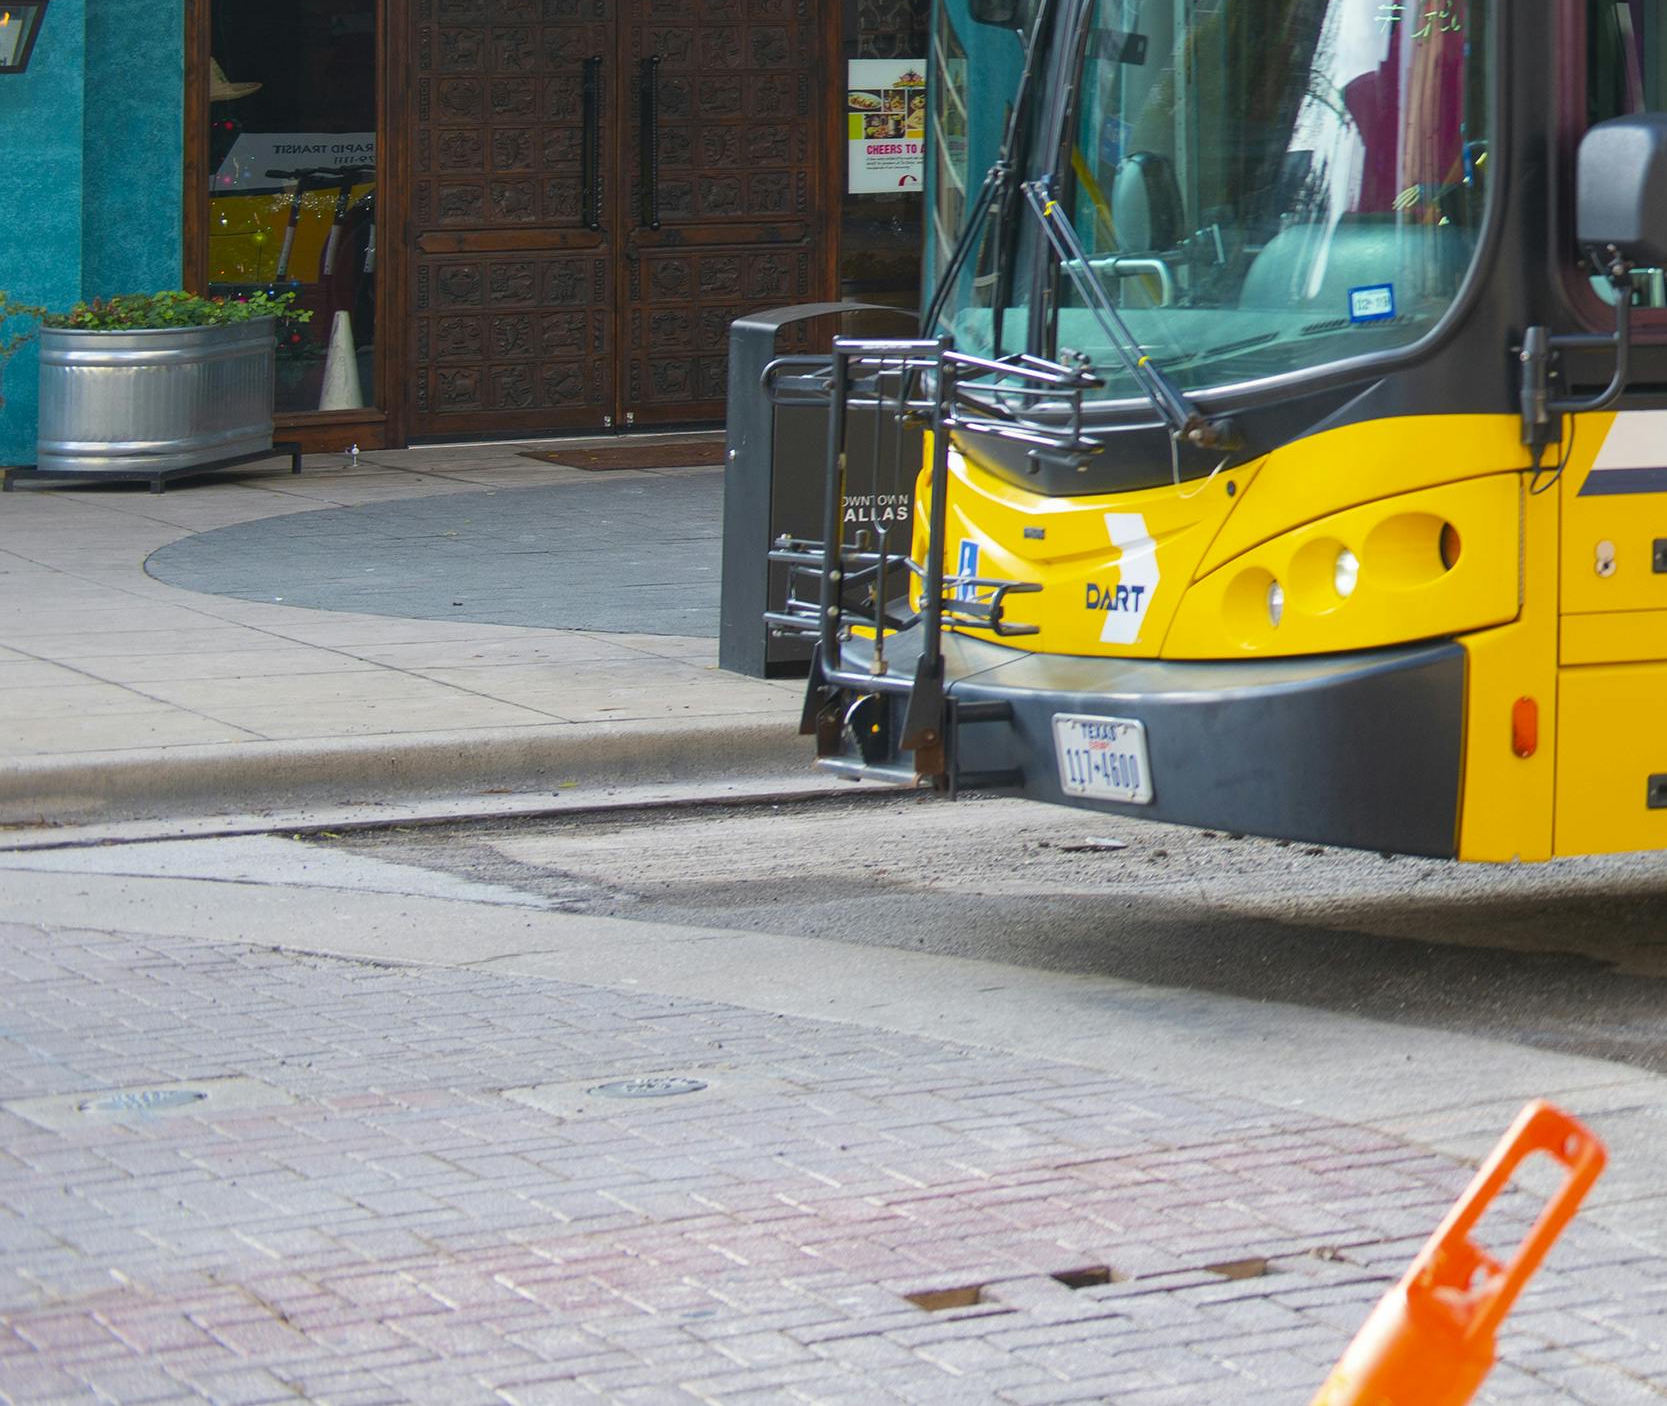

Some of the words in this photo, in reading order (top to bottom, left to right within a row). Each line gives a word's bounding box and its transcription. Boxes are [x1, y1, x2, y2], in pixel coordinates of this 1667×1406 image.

[866, 144, 903, 155] CHEERS
[905, 144, 917, 154] TO
[1085, 581, 1146, 613] DART
[1081, 722, 1117, 742] TEXAS
